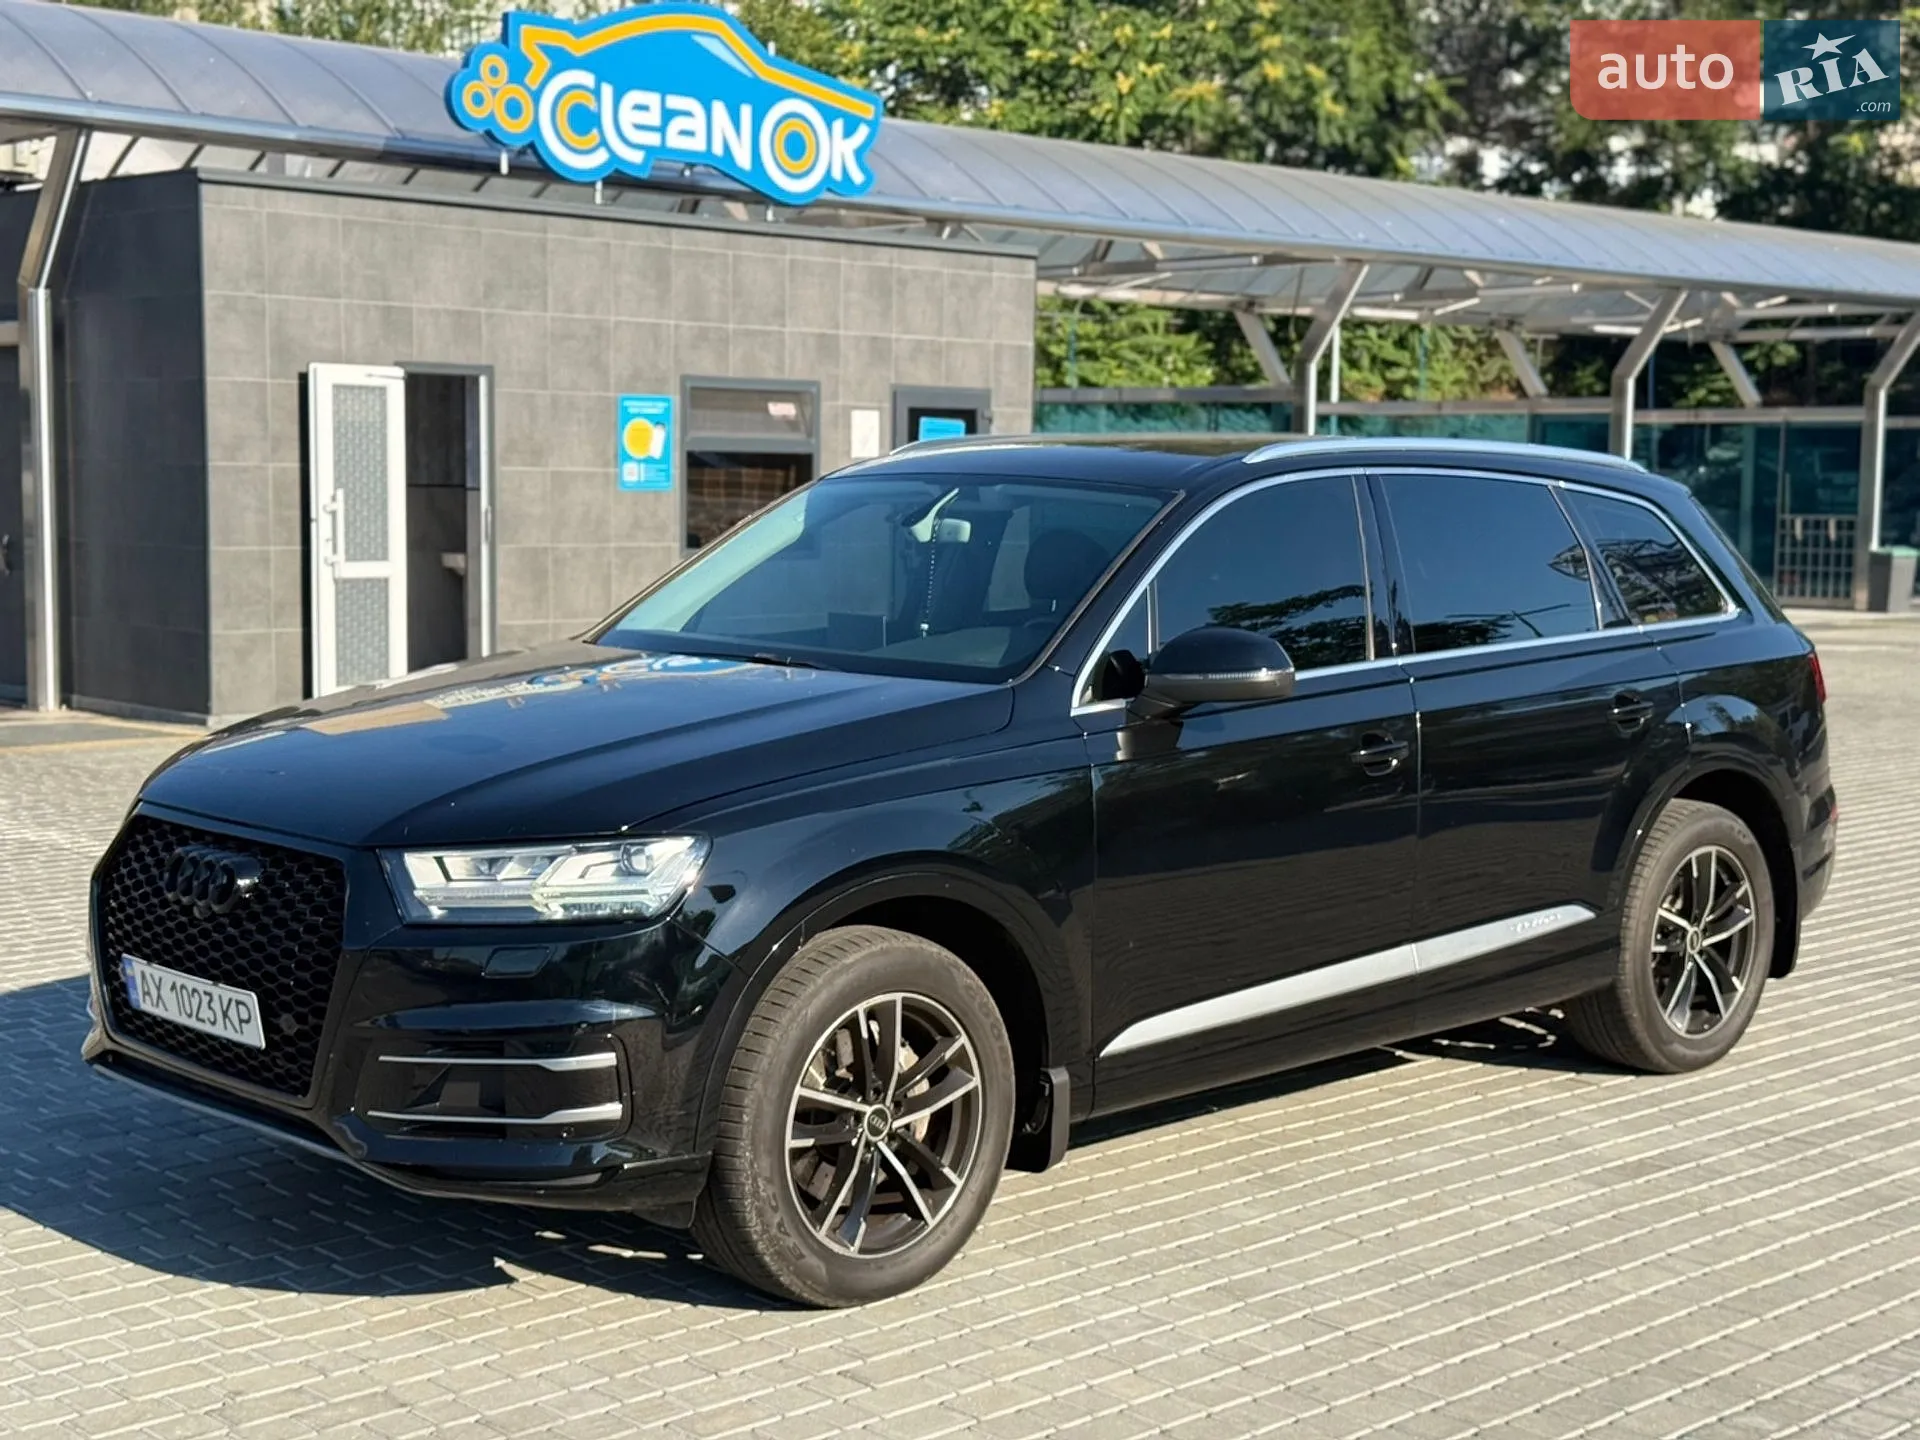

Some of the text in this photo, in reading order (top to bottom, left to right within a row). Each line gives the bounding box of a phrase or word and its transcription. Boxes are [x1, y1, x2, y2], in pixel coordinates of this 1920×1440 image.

[140, 970, 253, 1035] AX 1023 KP
